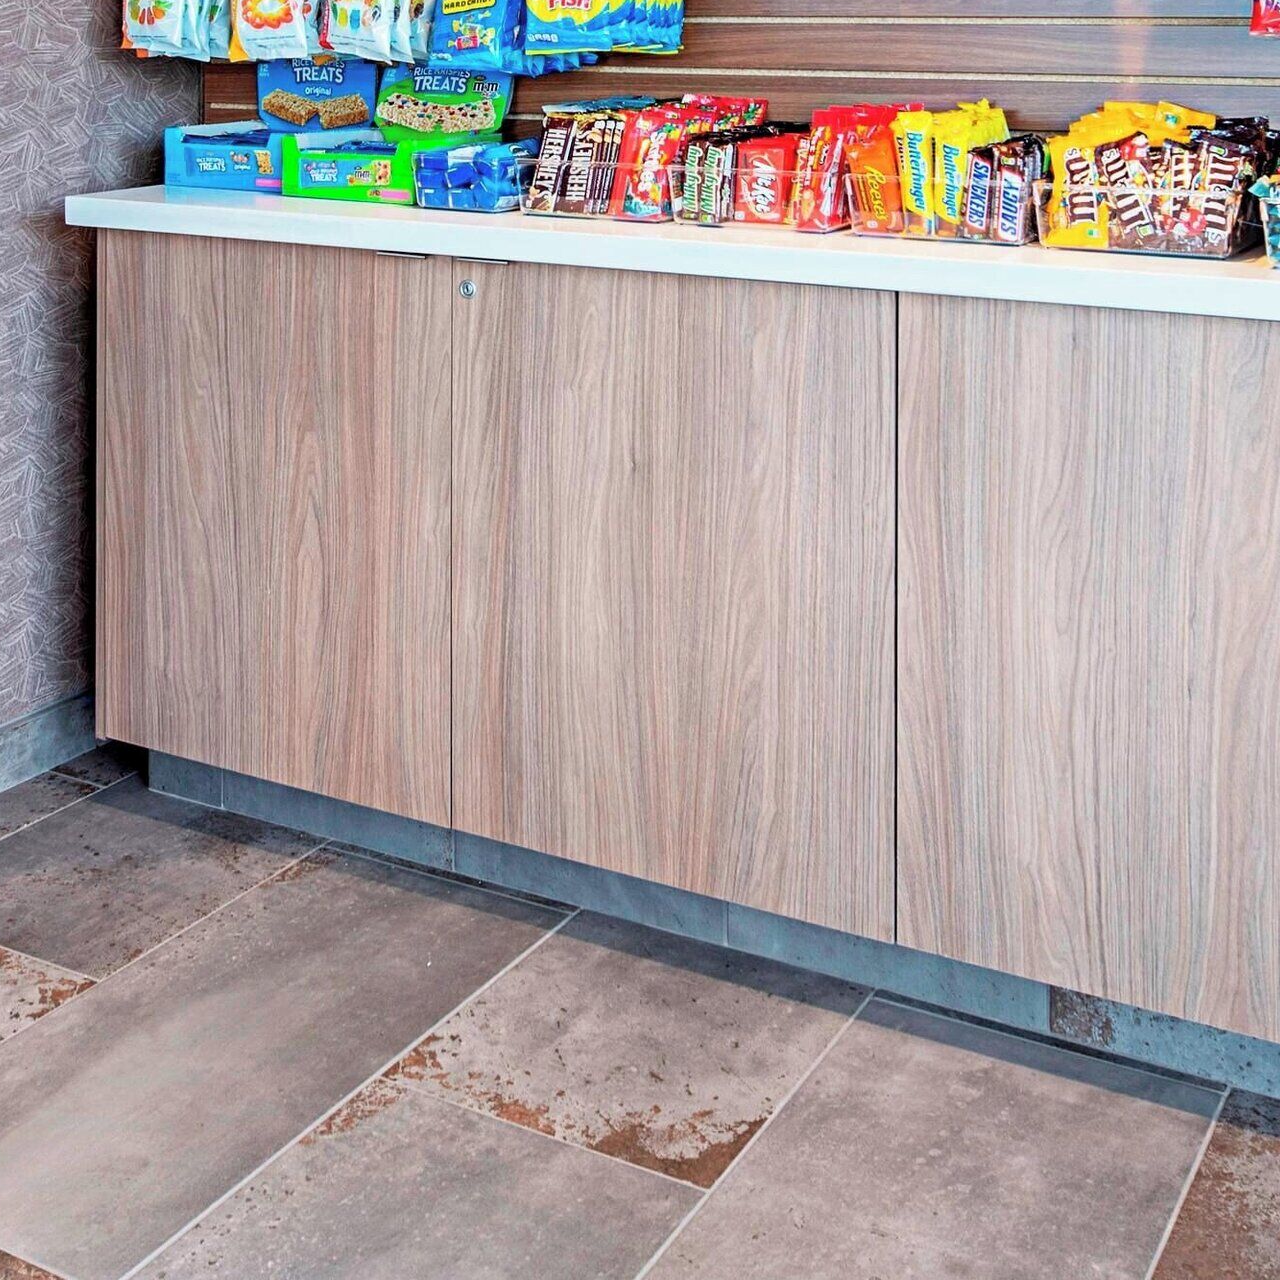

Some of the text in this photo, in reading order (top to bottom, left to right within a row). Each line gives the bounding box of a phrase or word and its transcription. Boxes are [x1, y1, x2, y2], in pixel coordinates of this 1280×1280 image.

[444, 0, 467, 10] HARD
[292, 58, 311, 69] RICE
[294, 67, 344, 83] TREATS
[414, 67, 433, 77] RICE
[304, 86, 332, 97] Original
[414, 76, 467, 93] TREATS
[199, 163, 226, 172] TREATS
[536, 128, 569, 200] HERSHEY'S
[565, 130, 594, 201] HERSHEY'S
[906, 131, 926, 211] Butterfinger
[311, 173, 338, 183] TREATS
[942, 144, 961, 221] Butterfinger
[966, 160, 990, 229] SNICKERS
[1000, 178, 1021, 237] SAUCY
